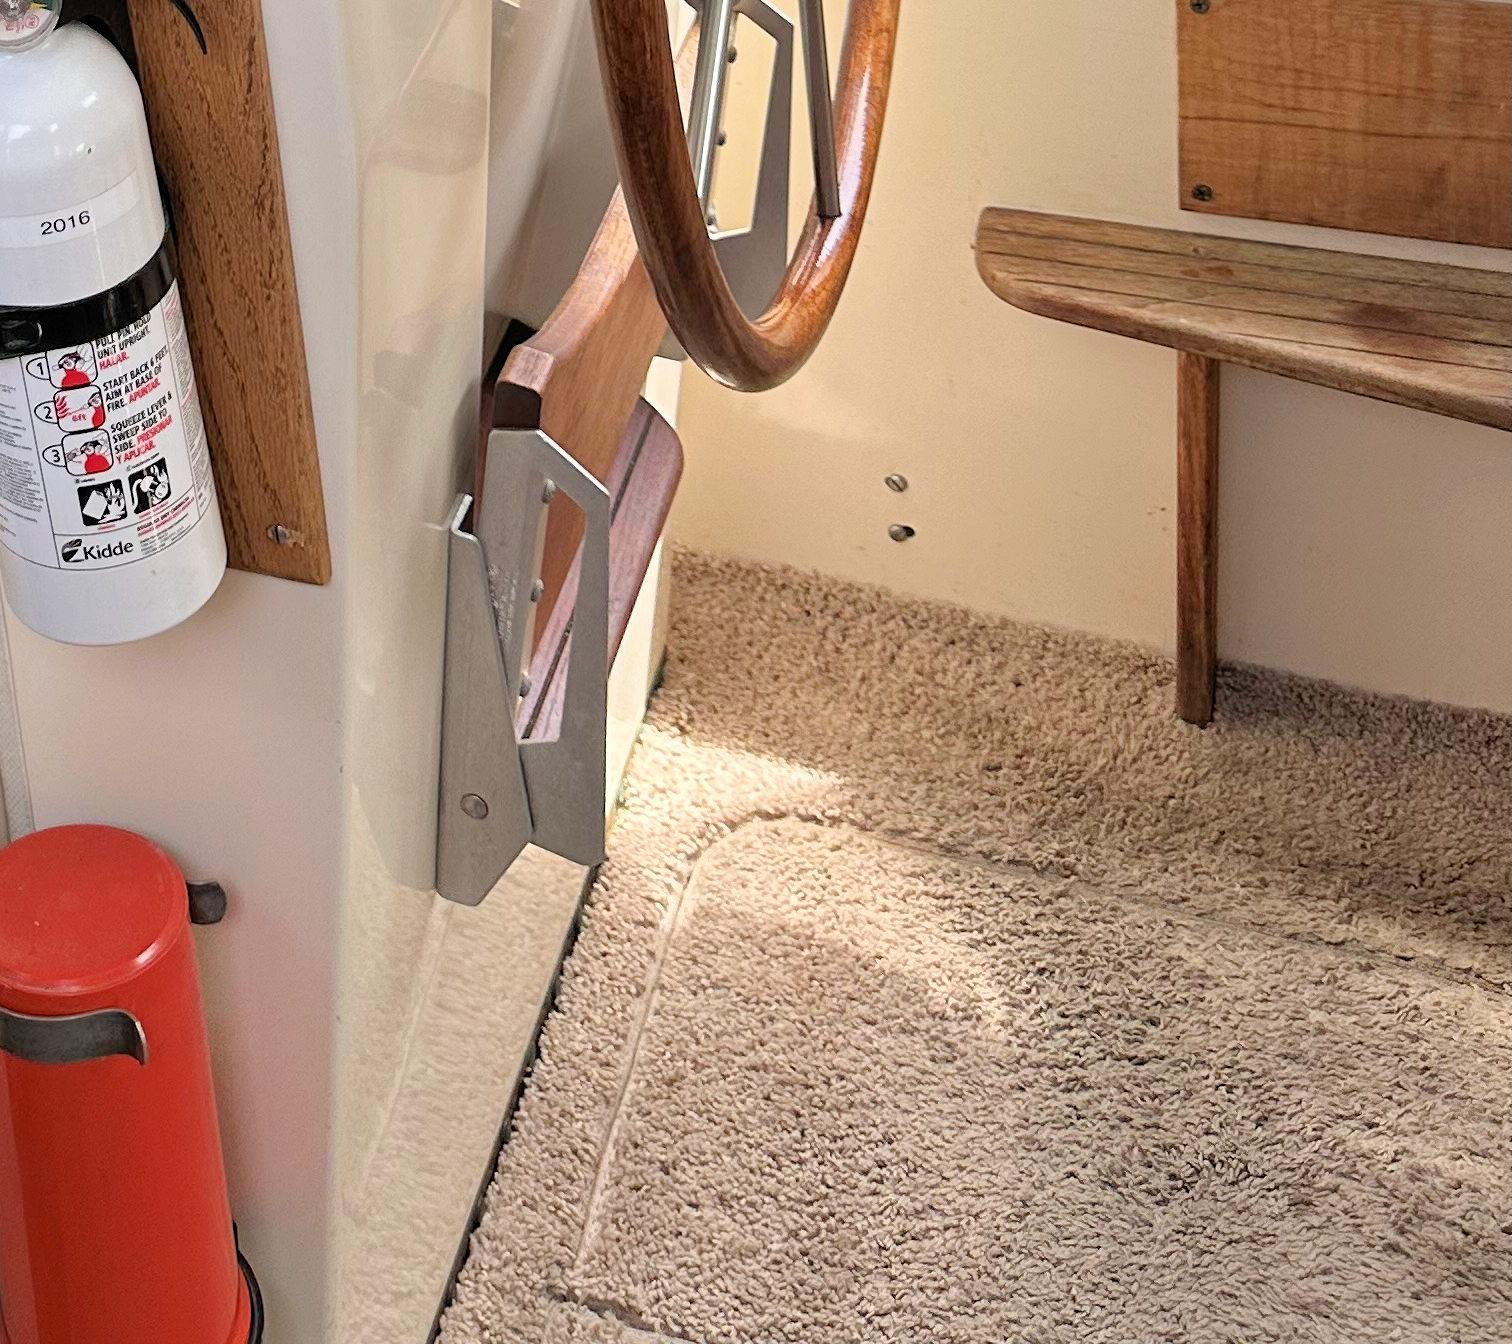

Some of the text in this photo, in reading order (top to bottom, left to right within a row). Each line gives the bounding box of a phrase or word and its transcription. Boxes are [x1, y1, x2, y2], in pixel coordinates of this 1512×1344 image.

[40, 210, 90, 235] 2016
[37, 362, 44, 375] 1
[102, 374, 128, 392] START
[124, 383, 134, 394] AT
[43, 406, 52, 419] 2
[110, 410, 146, 434] SQUEEZE
[52, 449, 61, 463] 3
[83, 541, 134, 560] Kidde
